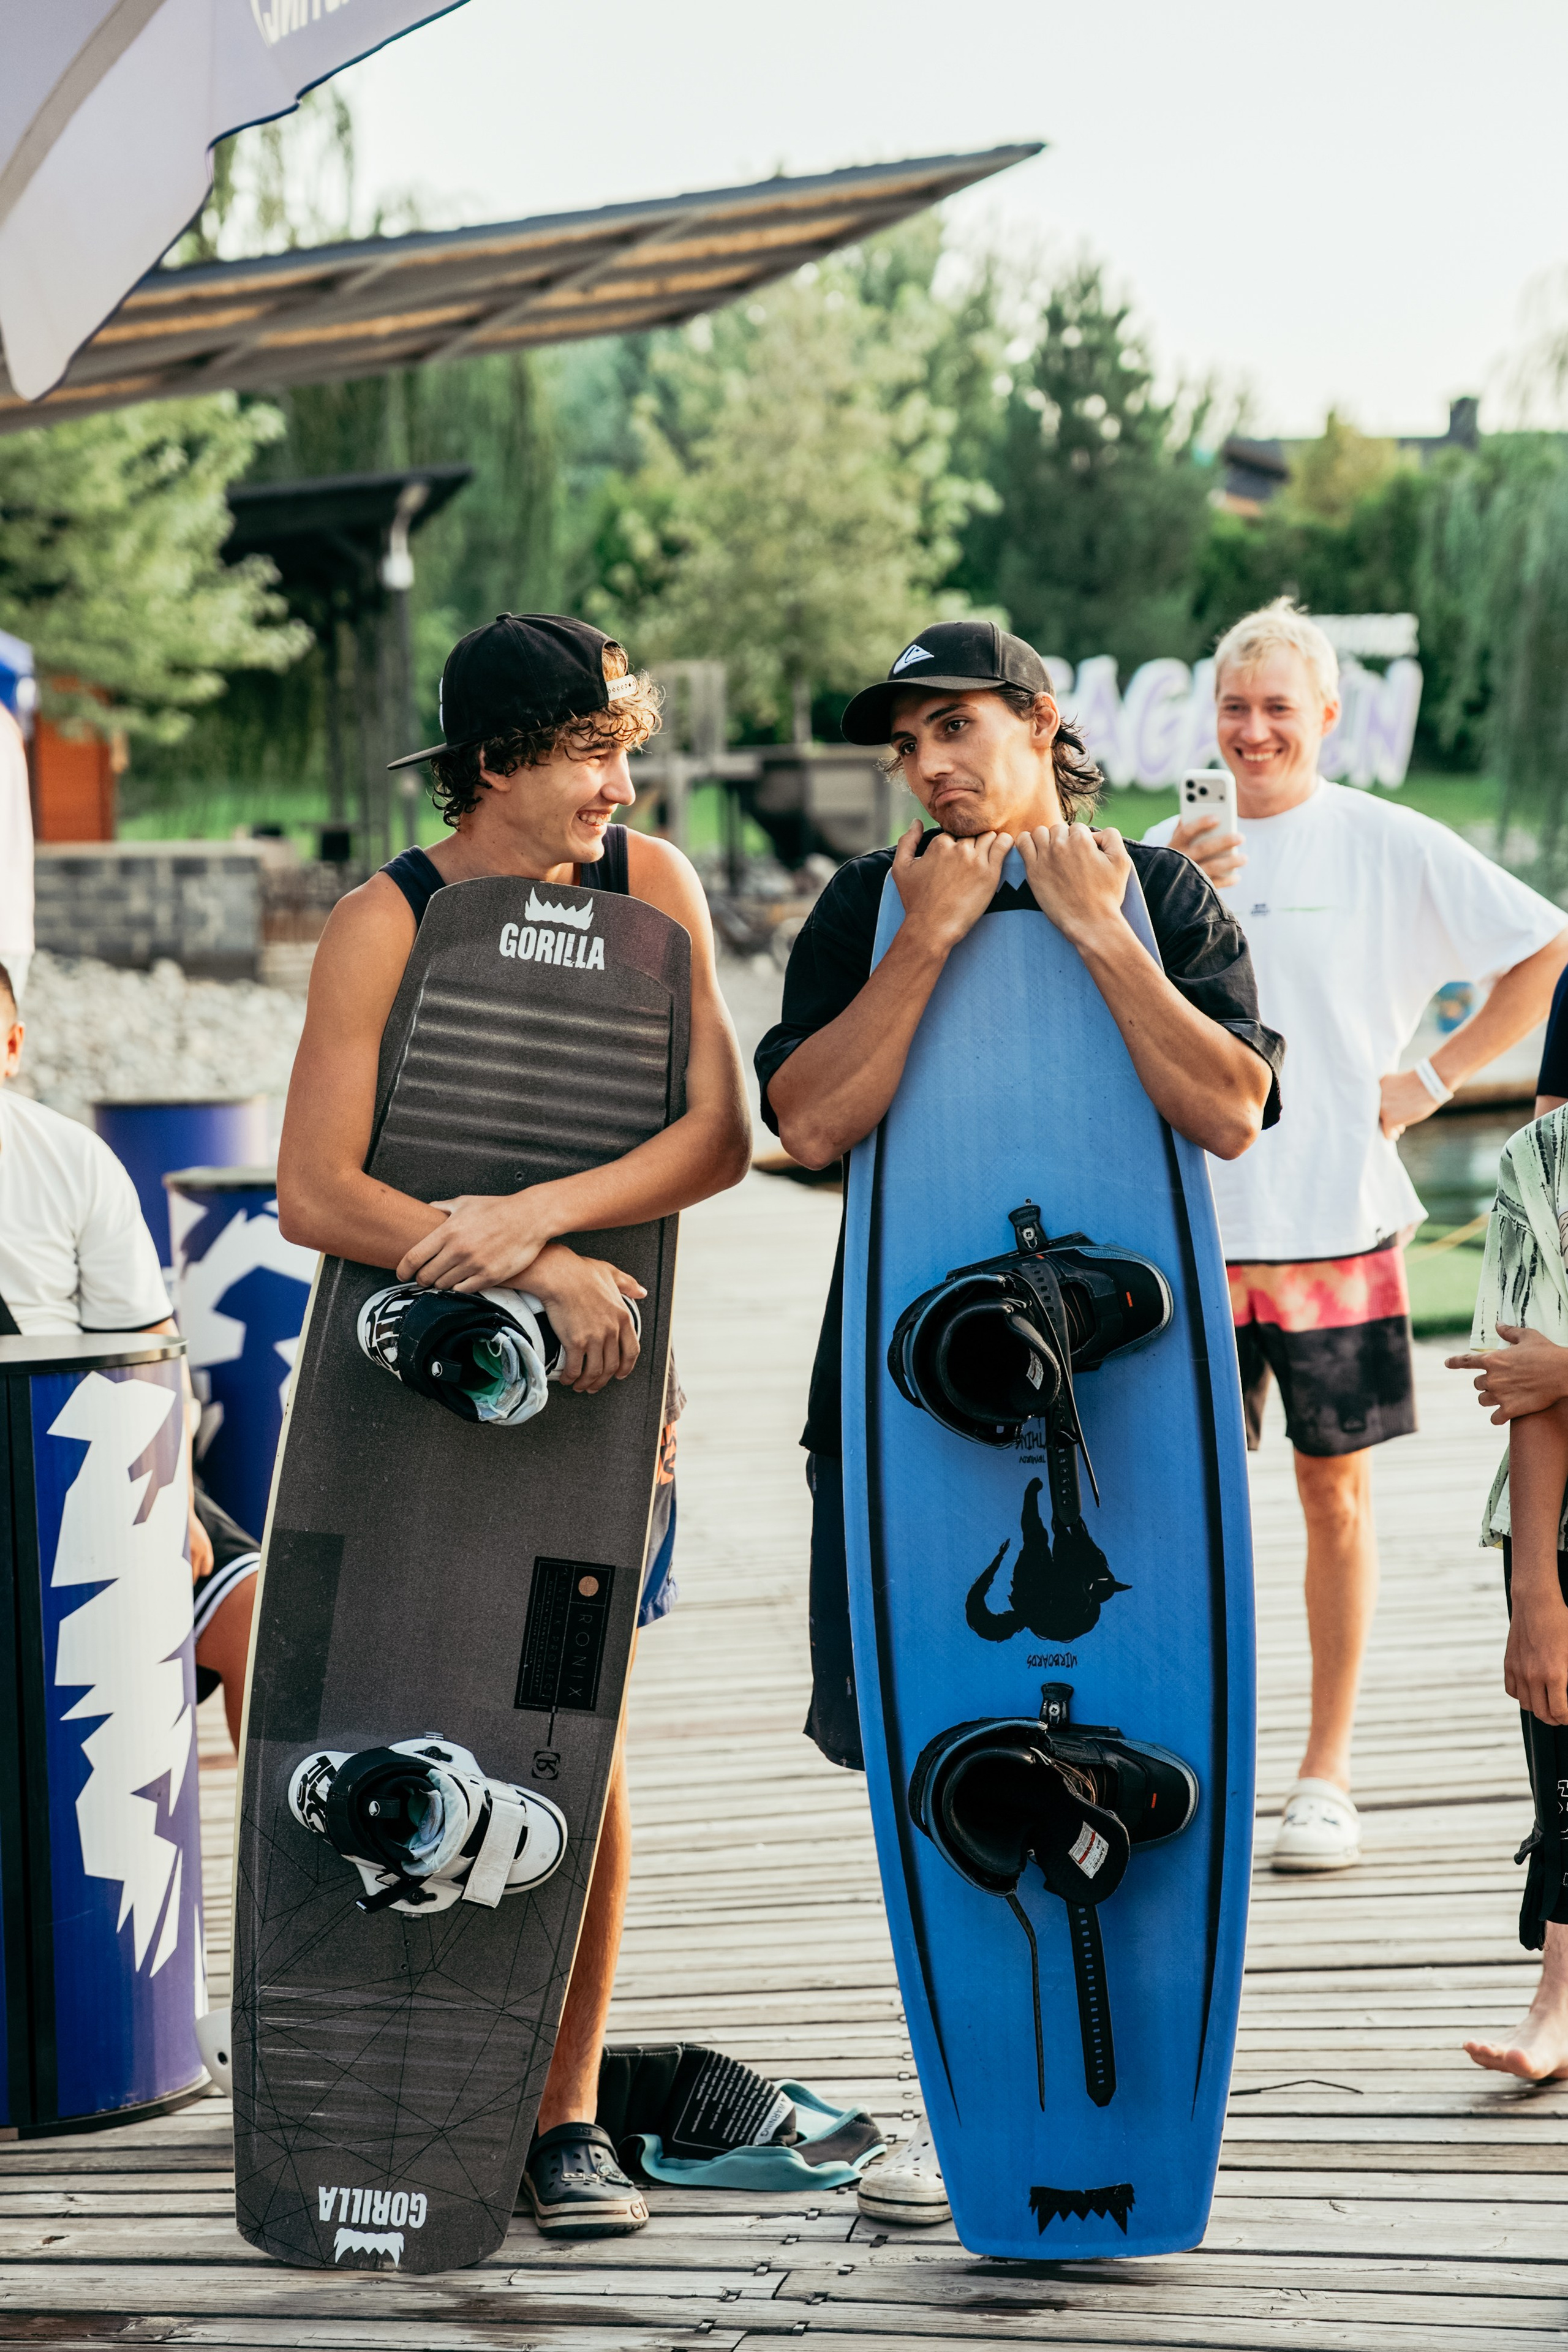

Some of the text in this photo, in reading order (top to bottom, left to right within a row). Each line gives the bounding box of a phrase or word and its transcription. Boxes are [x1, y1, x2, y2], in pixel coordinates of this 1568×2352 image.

[499, 922, 605, 970] GORILLA
[542, 1636, 559, 1698] PROJECT
[568, 1613, 592, 1697] RONIX
[760, 2103, 786, 2137] WARNING
[318, 2186, 428, 2228] GORILLA
